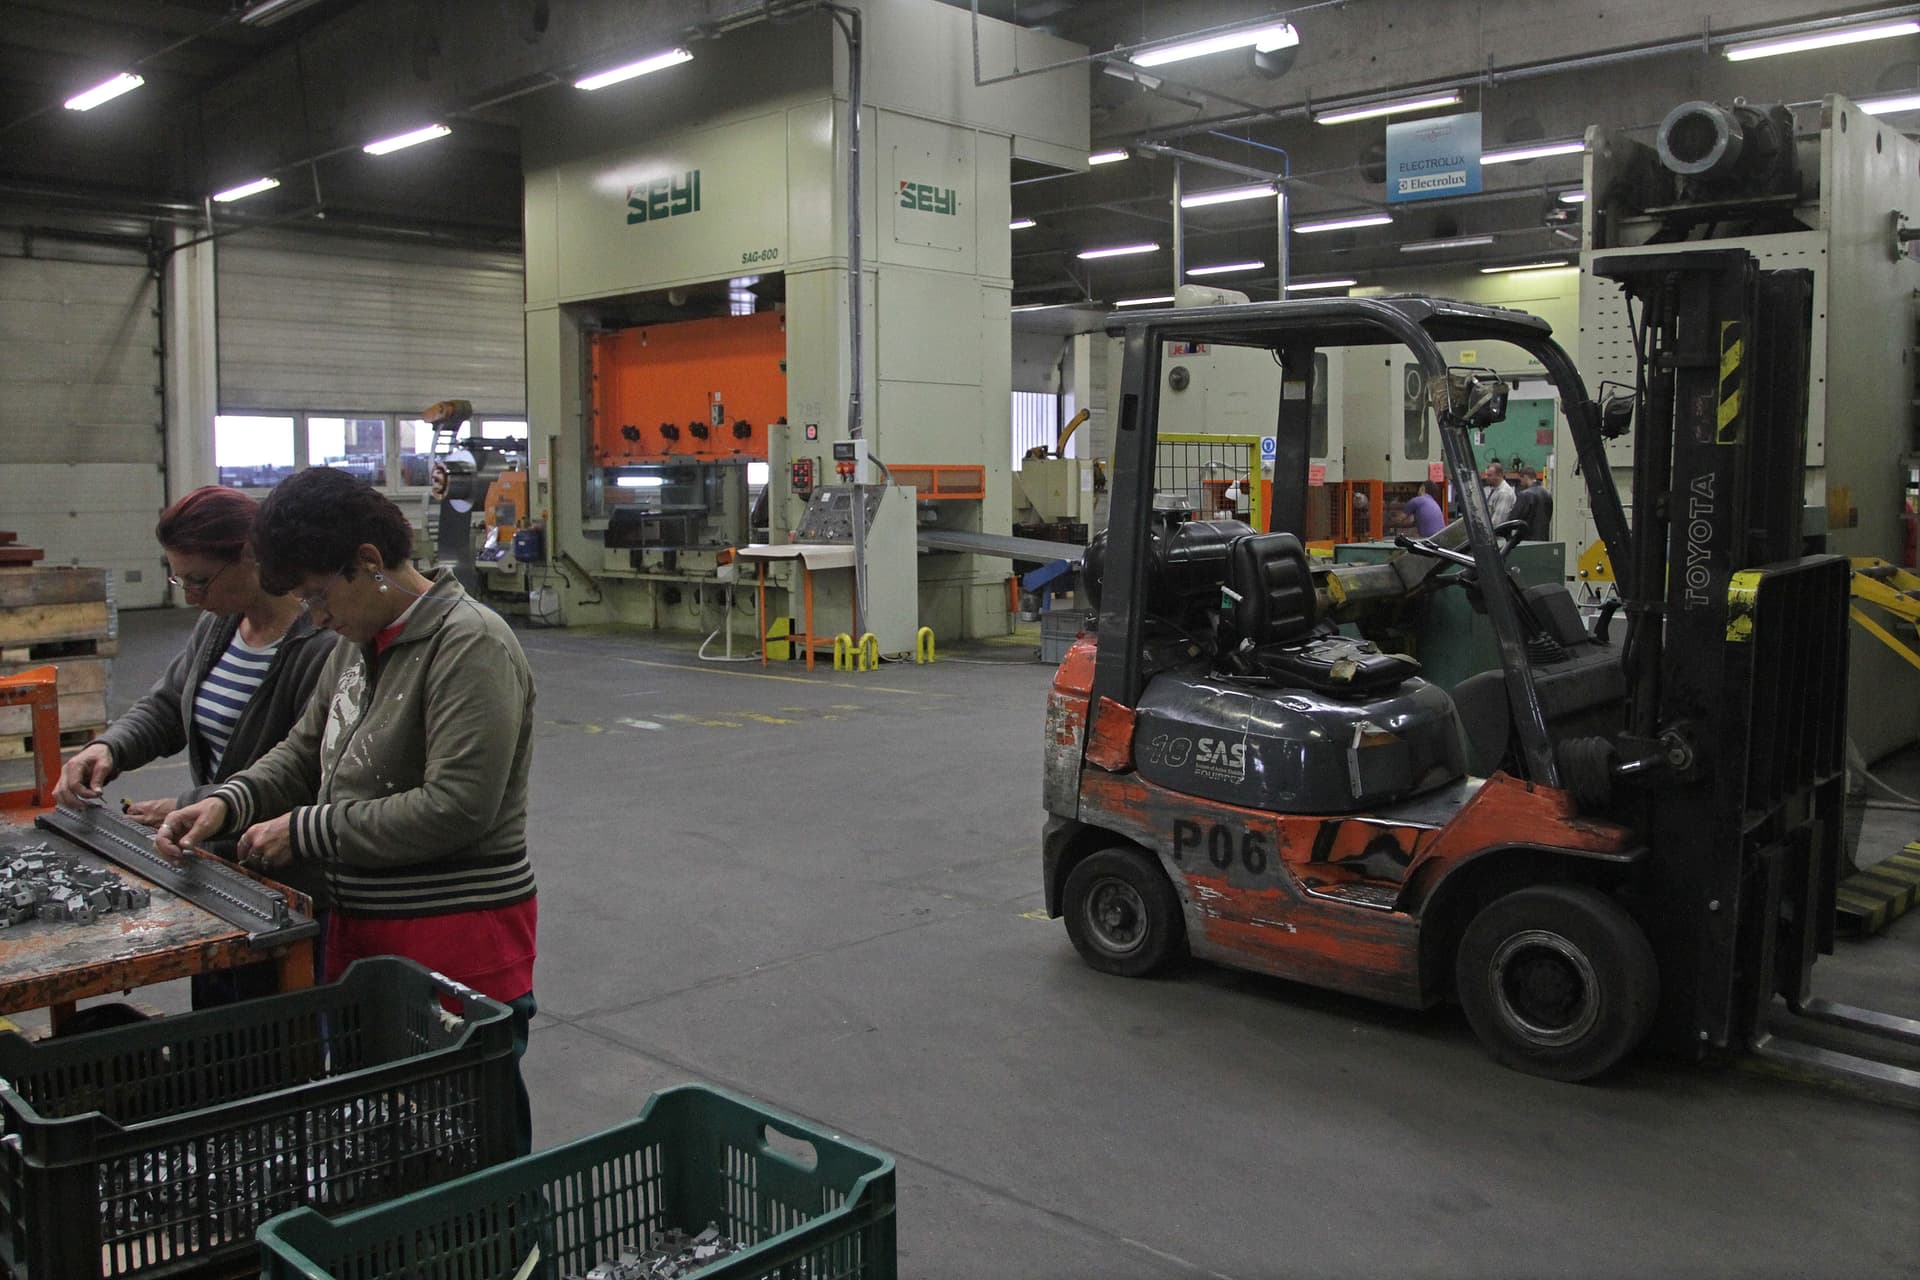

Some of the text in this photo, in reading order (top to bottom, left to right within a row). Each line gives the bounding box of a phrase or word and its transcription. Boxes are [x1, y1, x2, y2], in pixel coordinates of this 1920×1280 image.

[1399, 156, 1465, 172] ELECTROLUX
[627, 169, 700, 224] SEYI
[900, 181, 956, 216] SEYI
[1410, 175, 1465, 189] Electrolux
[741, 248, 778, 264] SAG-600
[1685, 473, 1716, 610] TOYOTA
[1196, 737, 1247, 768] SAS
[1173, 819, 1267, 875] P06
